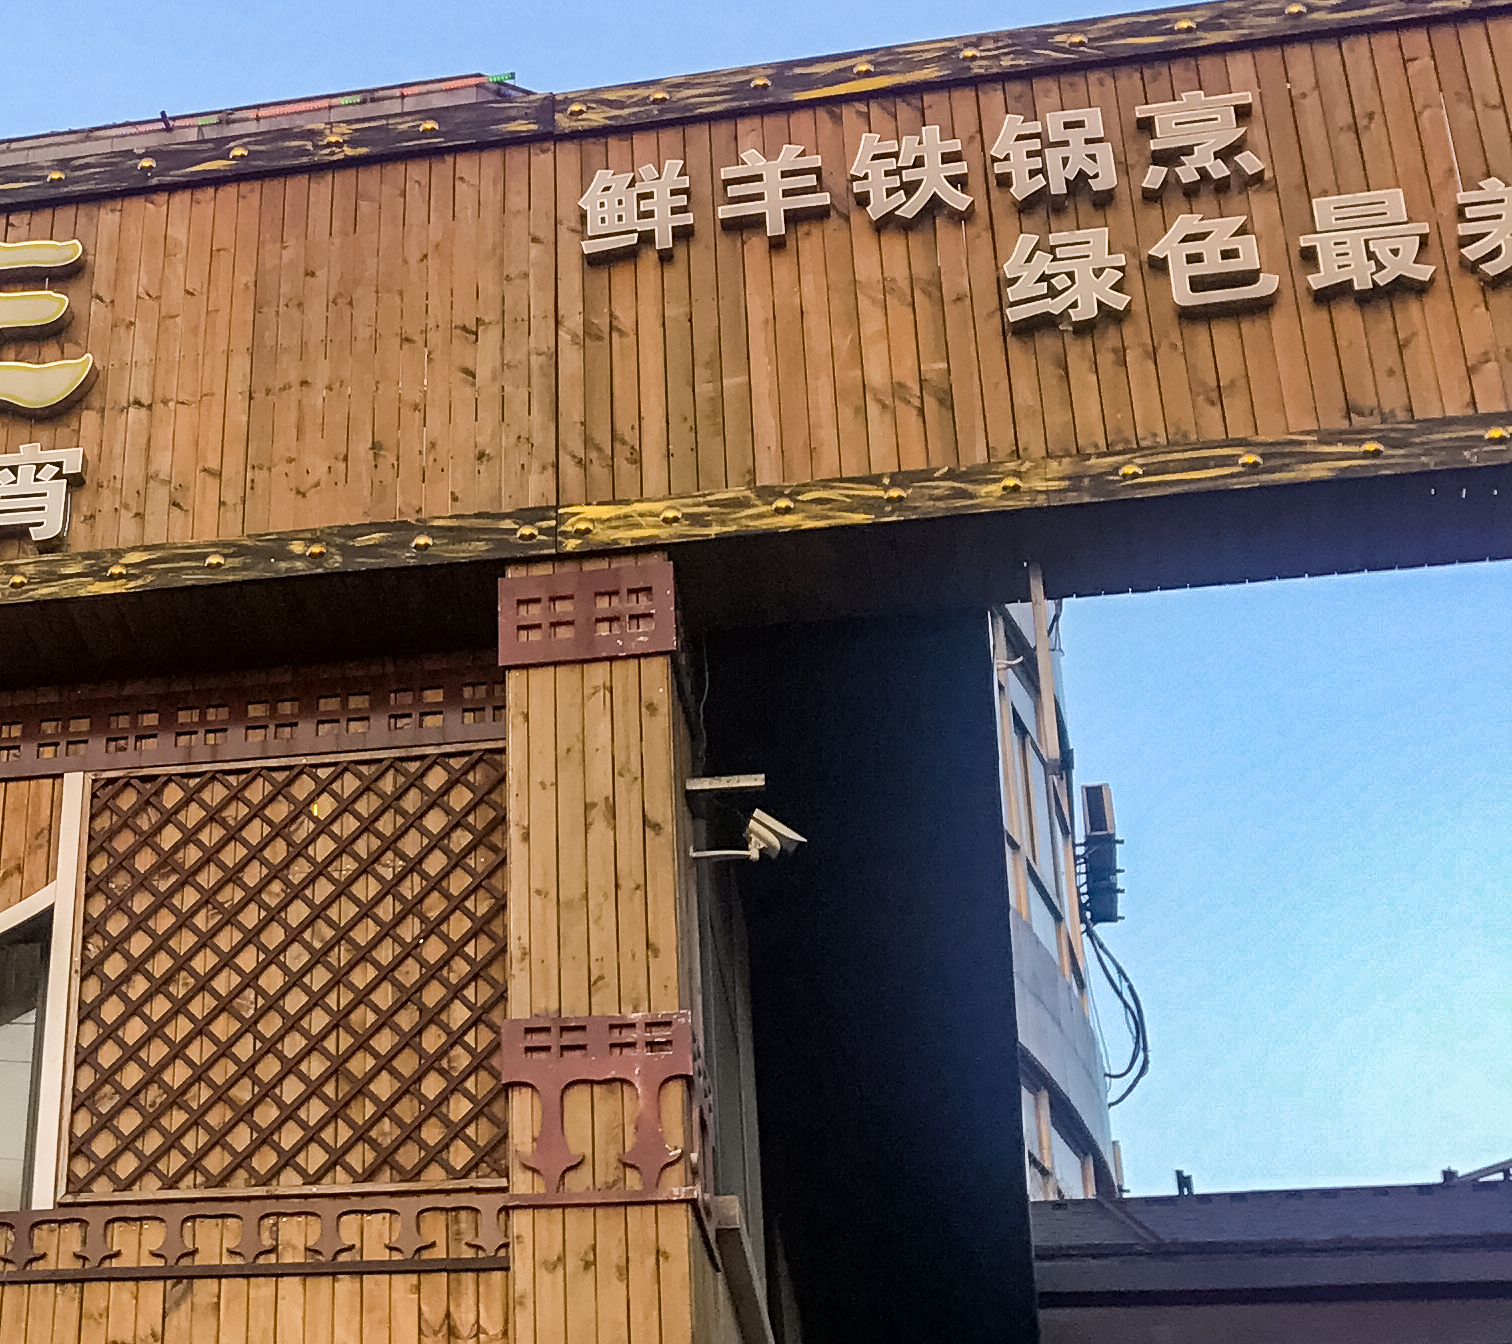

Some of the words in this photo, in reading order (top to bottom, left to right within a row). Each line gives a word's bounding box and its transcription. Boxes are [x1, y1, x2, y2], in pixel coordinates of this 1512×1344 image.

[579, 90, 1265, 256] 鲜羊铁锅烹
